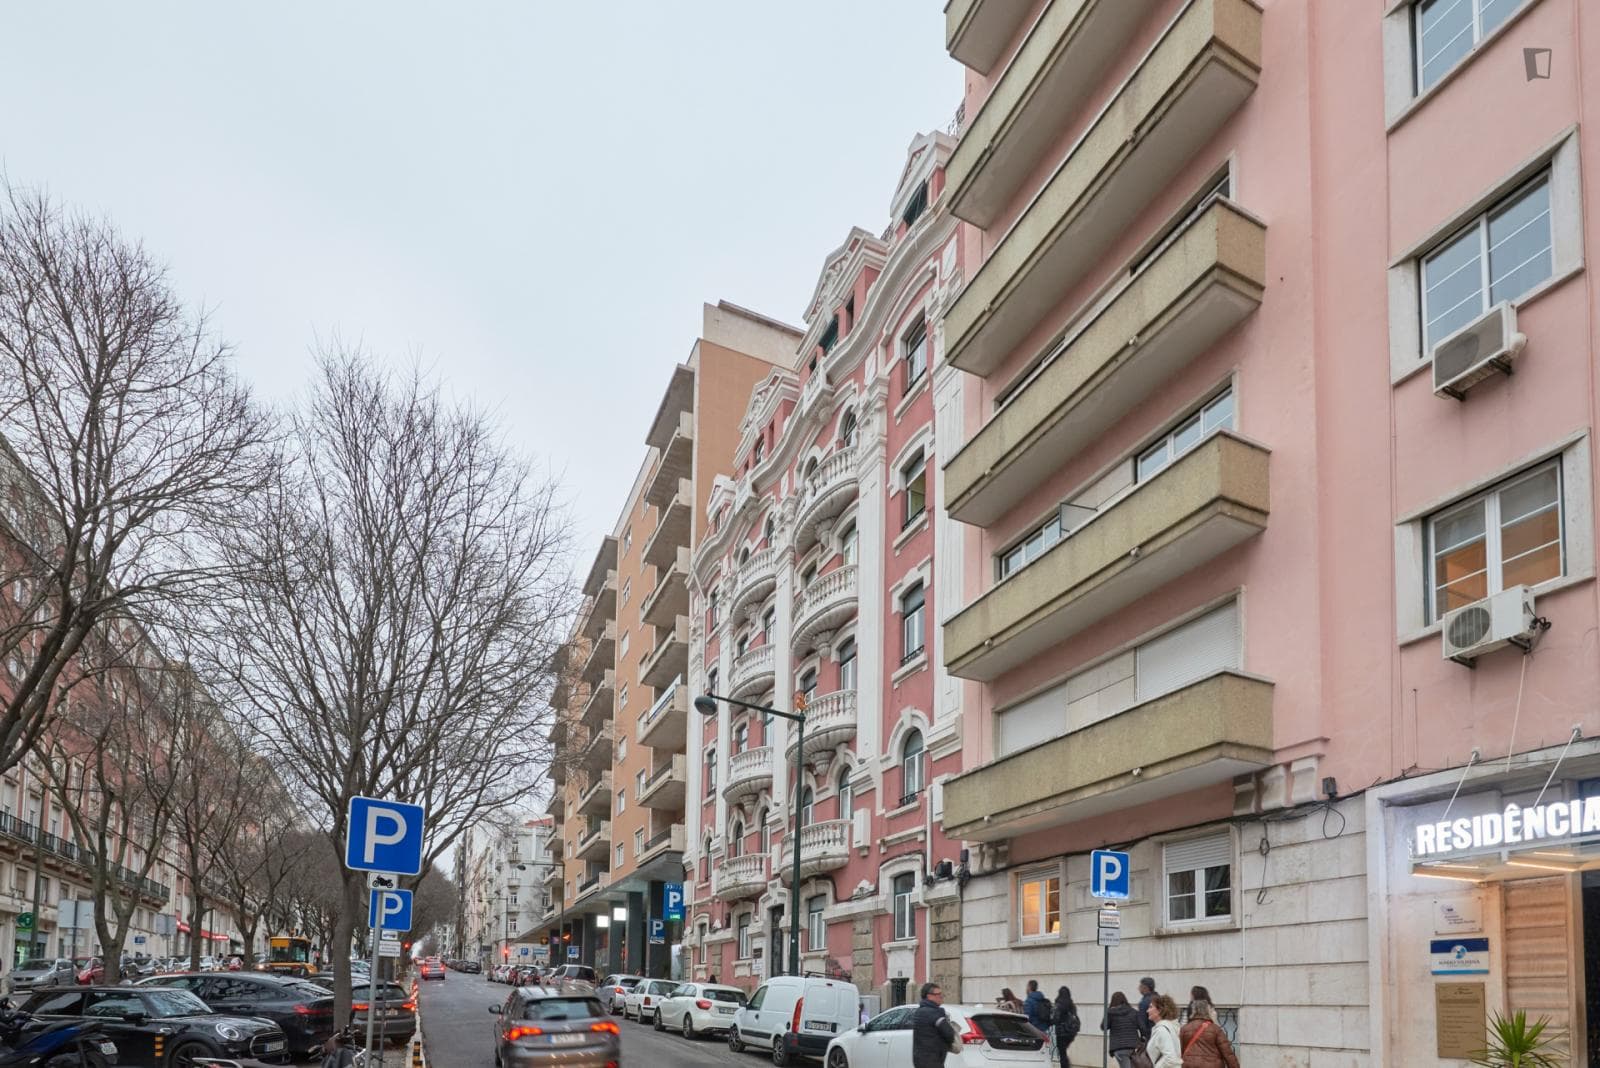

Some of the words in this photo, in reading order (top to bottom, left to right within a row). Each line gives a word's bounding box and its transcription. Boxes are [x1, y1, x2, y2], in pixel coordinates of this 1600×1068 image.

[363, 806, 407, 864] P
[1416, 796, 1600, 855] RESIDÊNCIA
[1099, 855, 1122, 896] P
[380, 892, 404, 926] P
[668, 891, 681, 908] P
[652, 920, 664, 936] P
